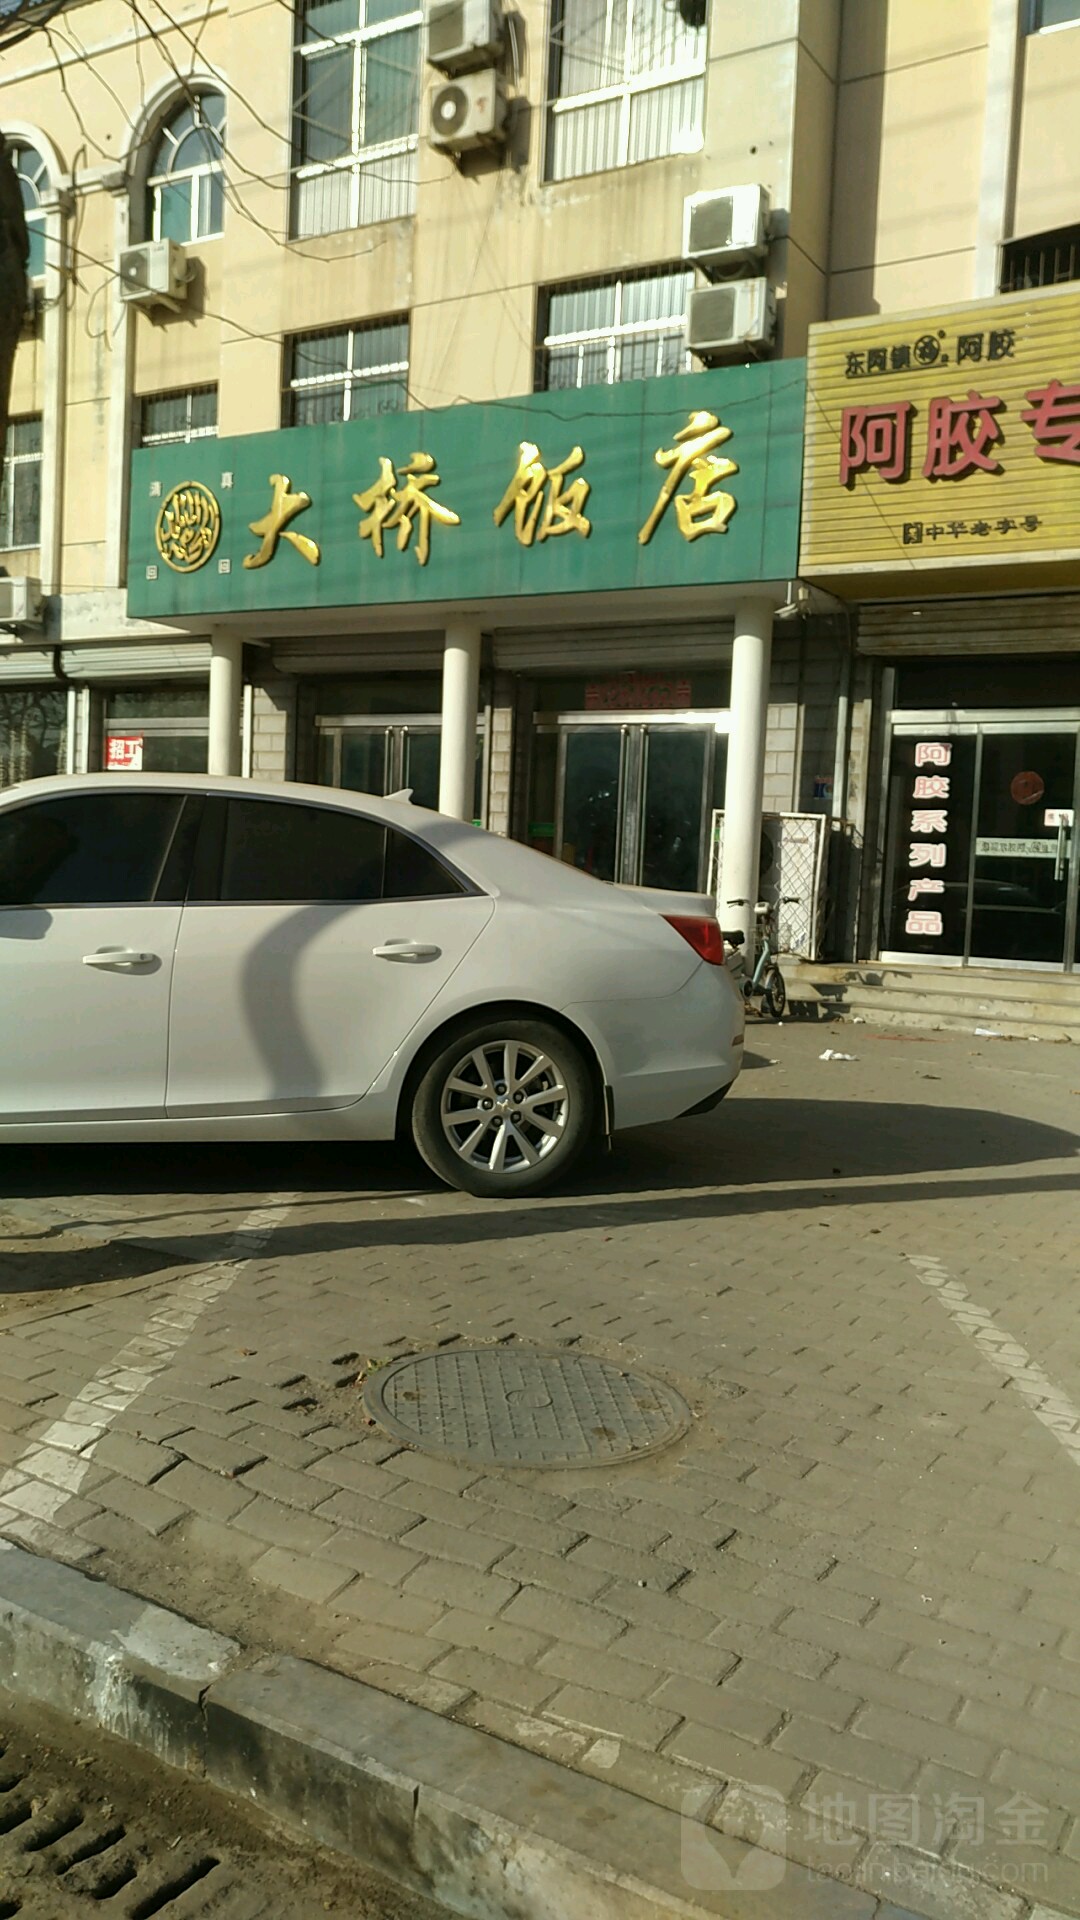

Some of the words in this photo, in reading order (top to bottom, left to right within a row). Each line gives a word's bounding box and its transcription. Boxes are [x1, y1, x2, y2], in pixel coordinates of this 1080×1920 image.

[243, 411, 739, 569] 大桥饭店
[925, 515, 1042, 541] 中华老字号
[108, 738, 144, 760] 招工
[905, 742, 952, 936] 阿胶系列产品
